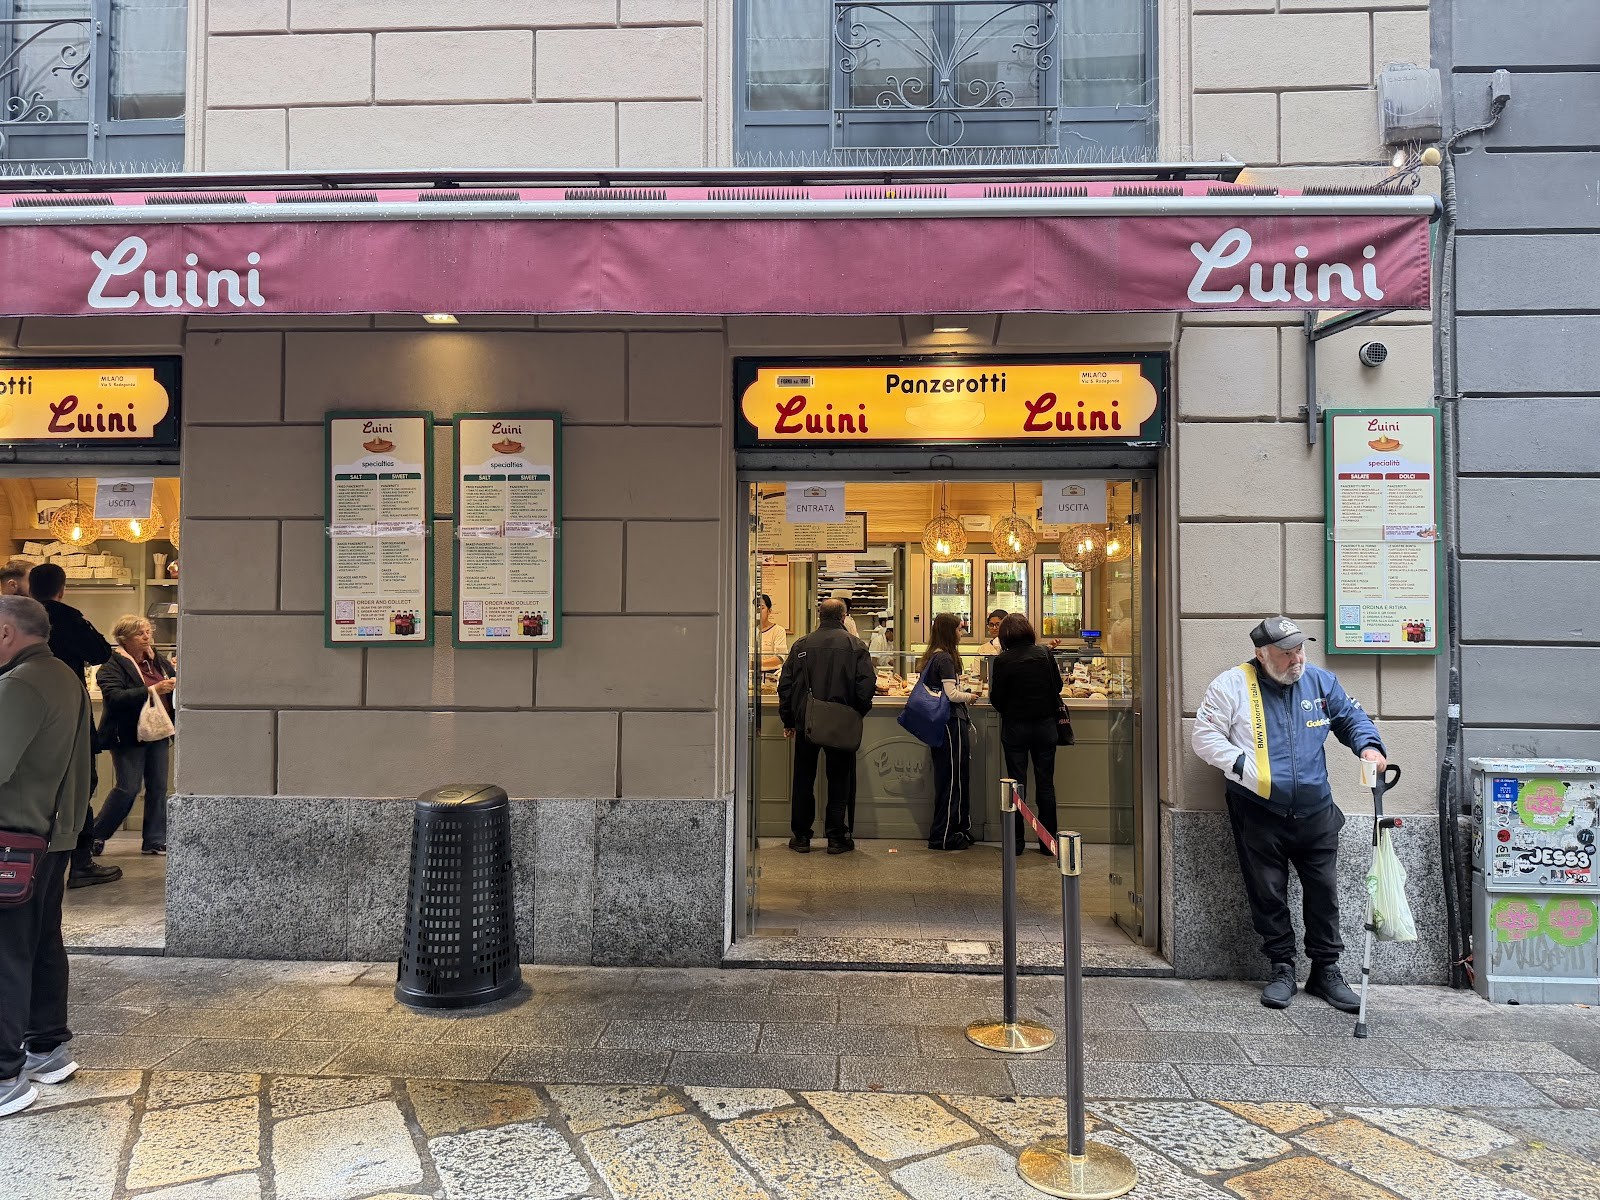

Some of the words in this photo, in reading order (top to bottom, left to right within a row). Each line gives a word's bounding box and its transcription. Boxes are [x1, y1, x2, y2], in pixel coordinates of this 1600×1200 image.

[87, 236, 266, 309] Luini
[1187, 227, 1385, 305] Luini
[886, 373, 1007, 394] Panzerotti
[48, 395, 137, 432] Luini
[774, 395, 869, 433] Luini
[1023, 392, 1122, 432] Luini
[362, 421, 393, 434] Luini
[491, 422, 522, 435] Luini
[1367, 418, 1400, 432] Luini
[361, 460, 395, 469] specialties
[490, 461, 523, 470] specialties
[1368, 459, 1400, 468] specialità
[108, 499, 137, 507] USCITA
[796, 504, 835, 512] ENTRATA
[1058, 503, 1090, 512] USCITA
[1250, 682, 1259, 699] Italia
[1252, 699, 1263, 730] Motorrad
[1256, 733, 1264, 749] BMW
[1528, 846, 1591, 869] JESS3
